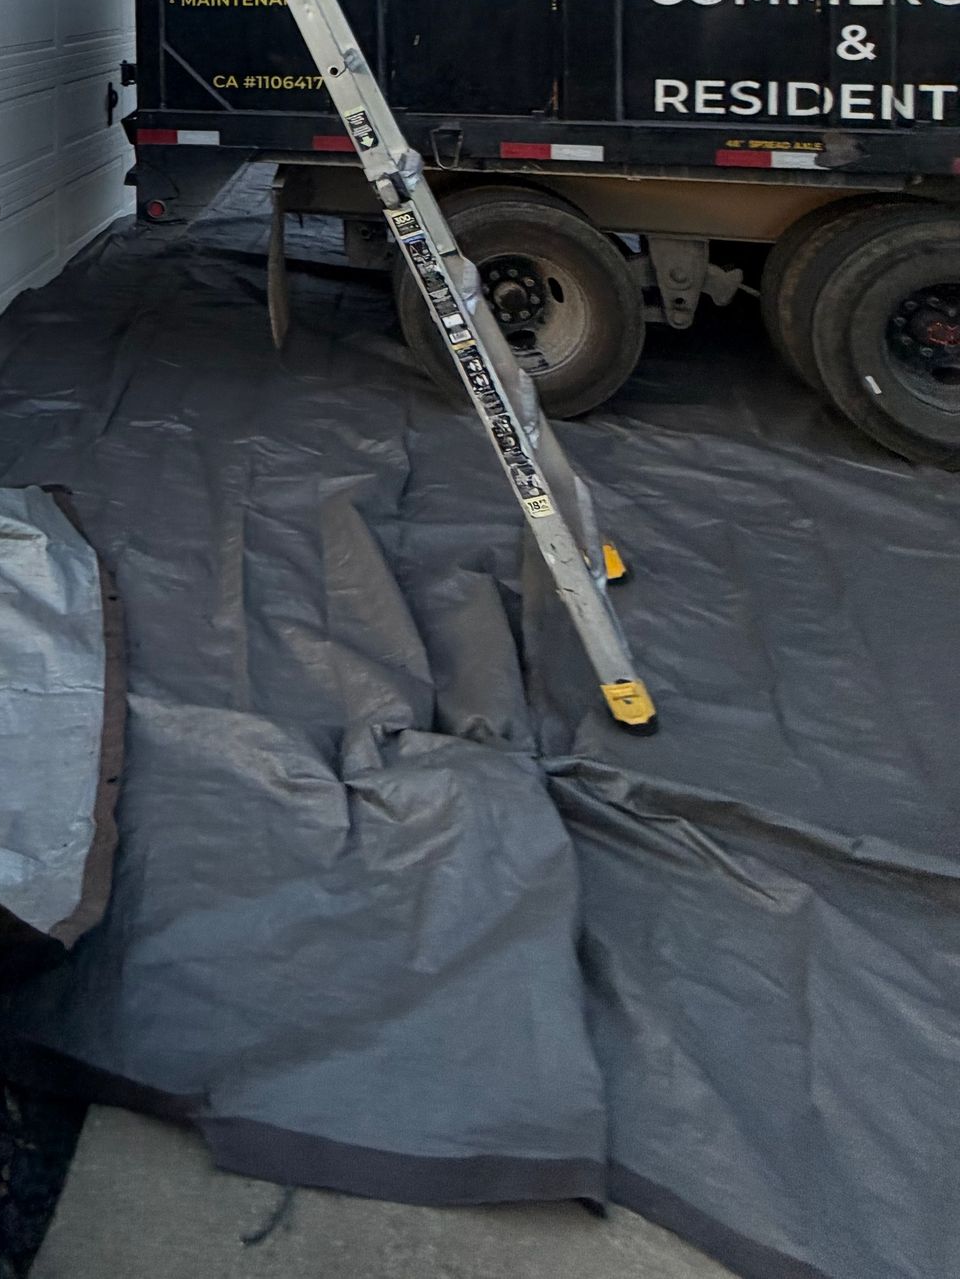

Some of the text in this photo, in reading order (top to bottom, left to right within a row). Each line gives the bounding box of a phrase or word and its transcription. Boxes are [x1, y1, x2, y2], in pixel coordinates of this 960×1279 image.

[836, 23, 878, 61] &
[212, 75, 324, 90] CA #1106417
[654, 78, 959, 121] RESIDENT
